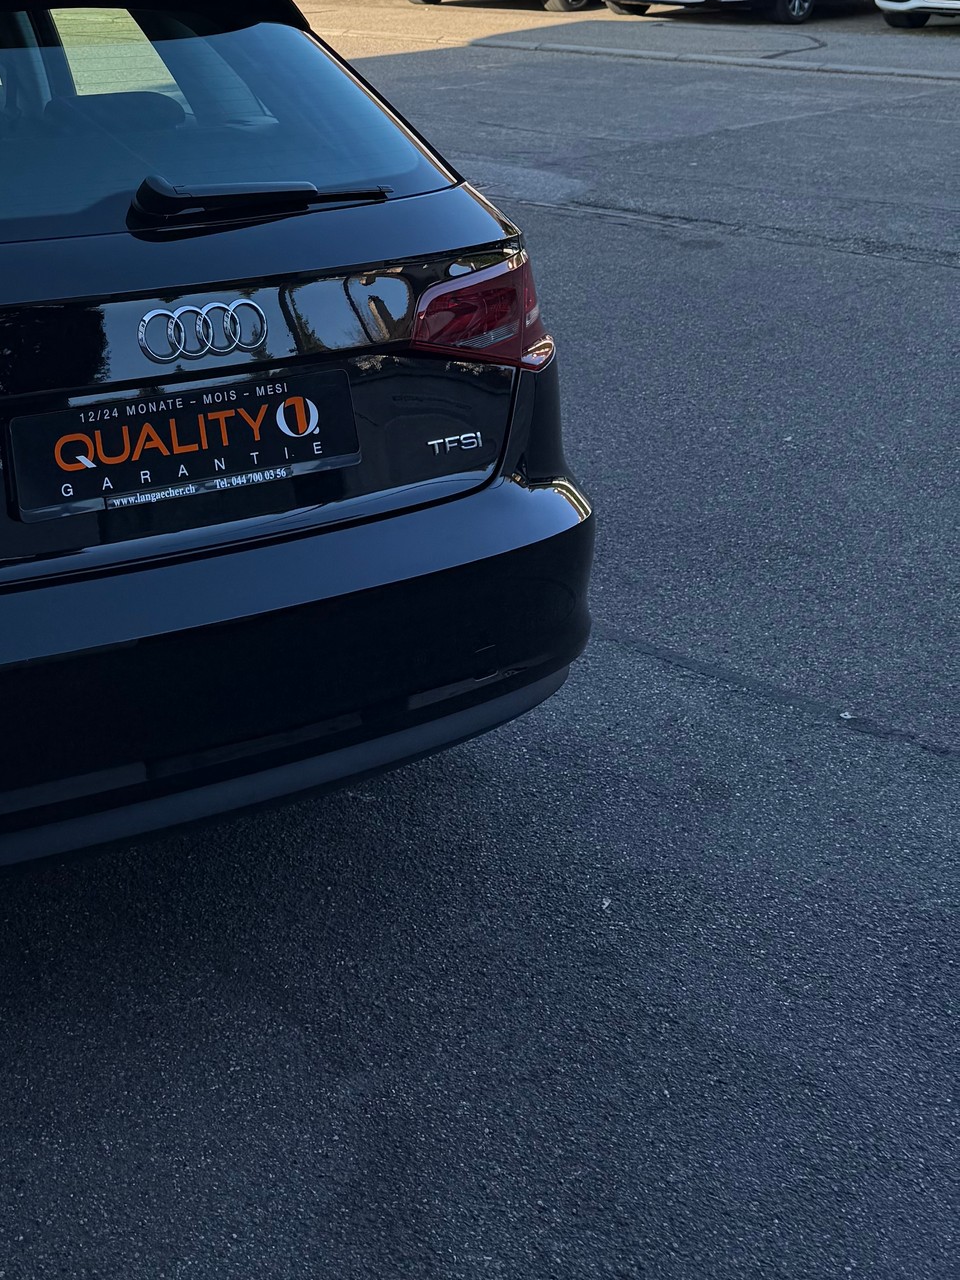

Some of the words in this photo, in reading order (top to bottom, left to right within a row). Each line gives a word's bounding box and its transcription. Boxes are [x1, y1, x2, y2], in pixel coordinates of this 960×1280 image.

[80, 407, 119, 423] 12/24
[126, 397, 184, 416] MONATE
[203, 390, 238, 405] MOIS
[256, 382, 288, 397] MESI
[54, 404, 269, 471] QUALITY
[427, 431, 483, 455] TFSI
[60, 441, 324, 497] GARANTIE
[113, 483, 196, 507] www.langaecher.ch
[213, 477, 231, 489] Tel.
[231, 475, 247, 487] 044
[247, 472, 263, 483] 700
